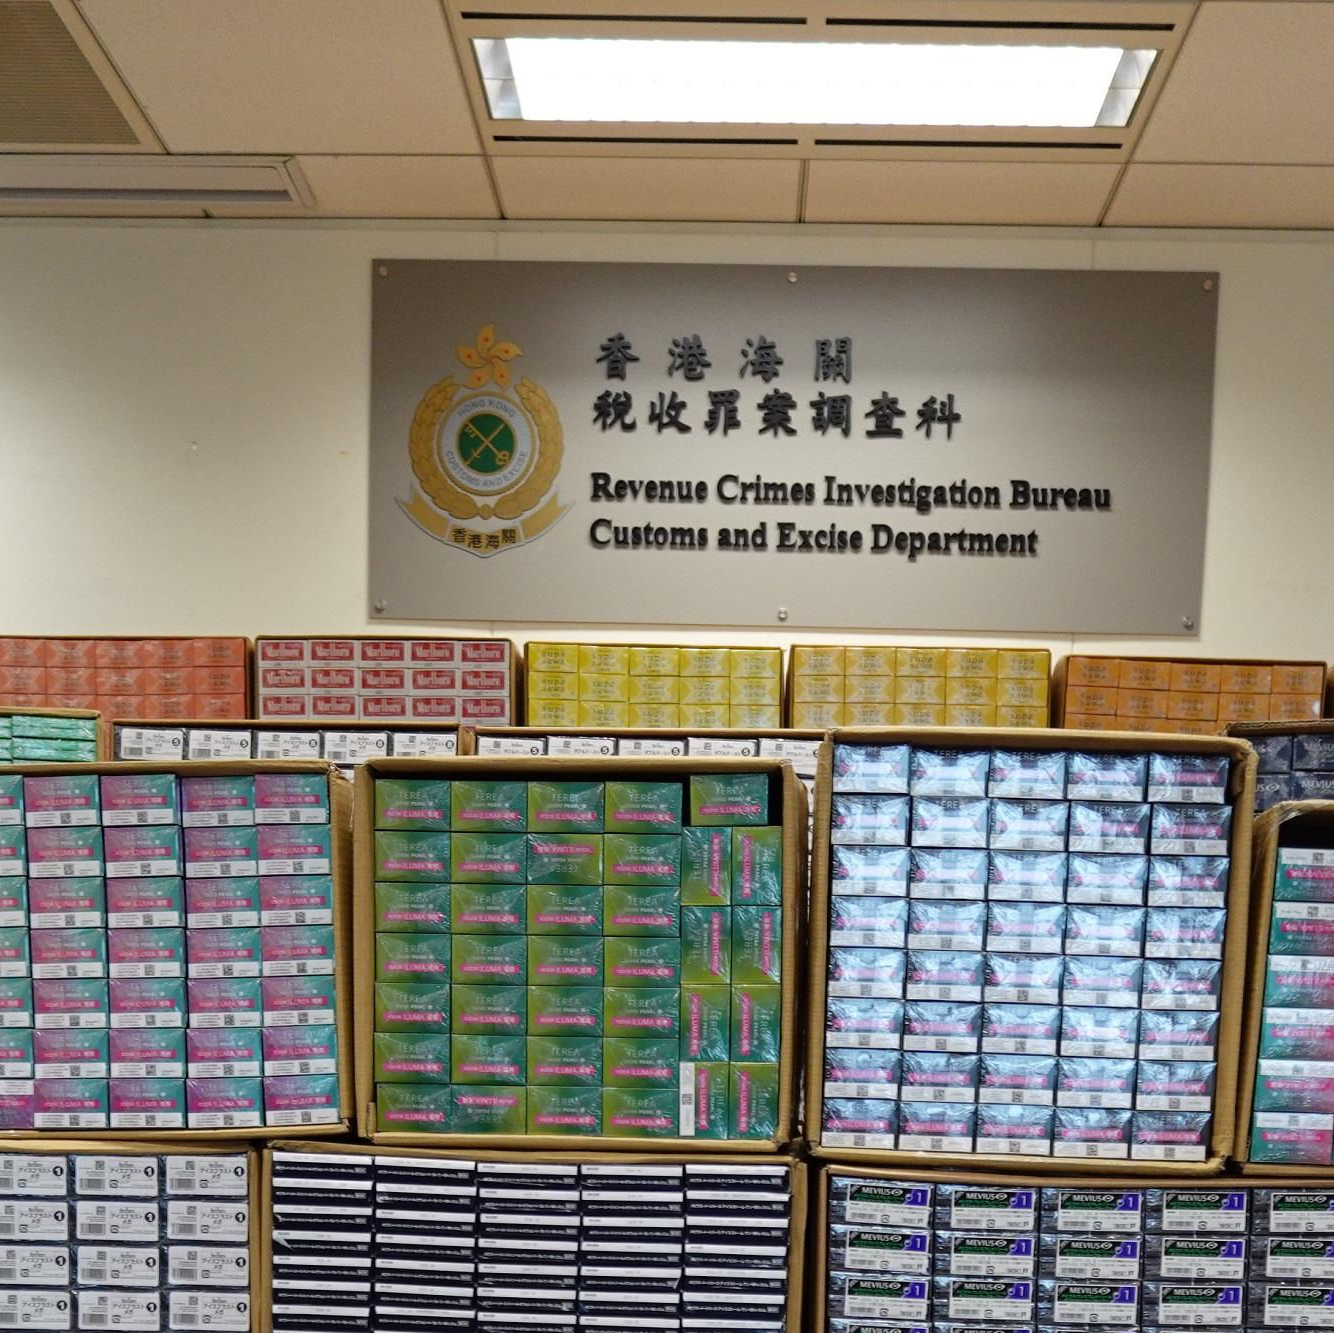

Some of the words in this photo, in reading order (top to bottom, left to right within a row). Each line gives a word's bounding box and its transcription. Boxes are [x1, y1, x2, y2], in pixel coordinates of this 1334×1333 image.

[595, 332, 853, 385] 香港海關
[445, 450, 480, 487] CUSTOMS
[483, 478, 503, 488] AND
[503, 450, 529, 482] EXCISE
[590, 471, 709, 502] Revenue
[716, 474, 816, 504] Crimes
[823, 475, 1002, 515] Investigation
[1009, 479, 1113, 510] Bureau
[452, 528, 517, 550] 香港海關
[589, 518, 709, 548] Customs
[717, 521, 768, 550] and
[775, 521, 864, 552] Excise
[870, 523, 1039, 562] Department
[266, 642, 302, 658] Marlboro
[316, 642, 352, 658] Marlboro
[366, 642, 402, 658] Marlboro
[416, 642, 452, 658] Marlboro
[467, 643, 503, 659] Marlboro
[861, 1186, 892, 1196] MEVIUS
[965, 1191, 996, 1201] MEVIUS
[1072, 1193, 1103, 1203] MEVIUS
[1177, 1193, 1208, 1203] MEVIUS
[1284, 1194, 1315, 1204] MEVIUS
